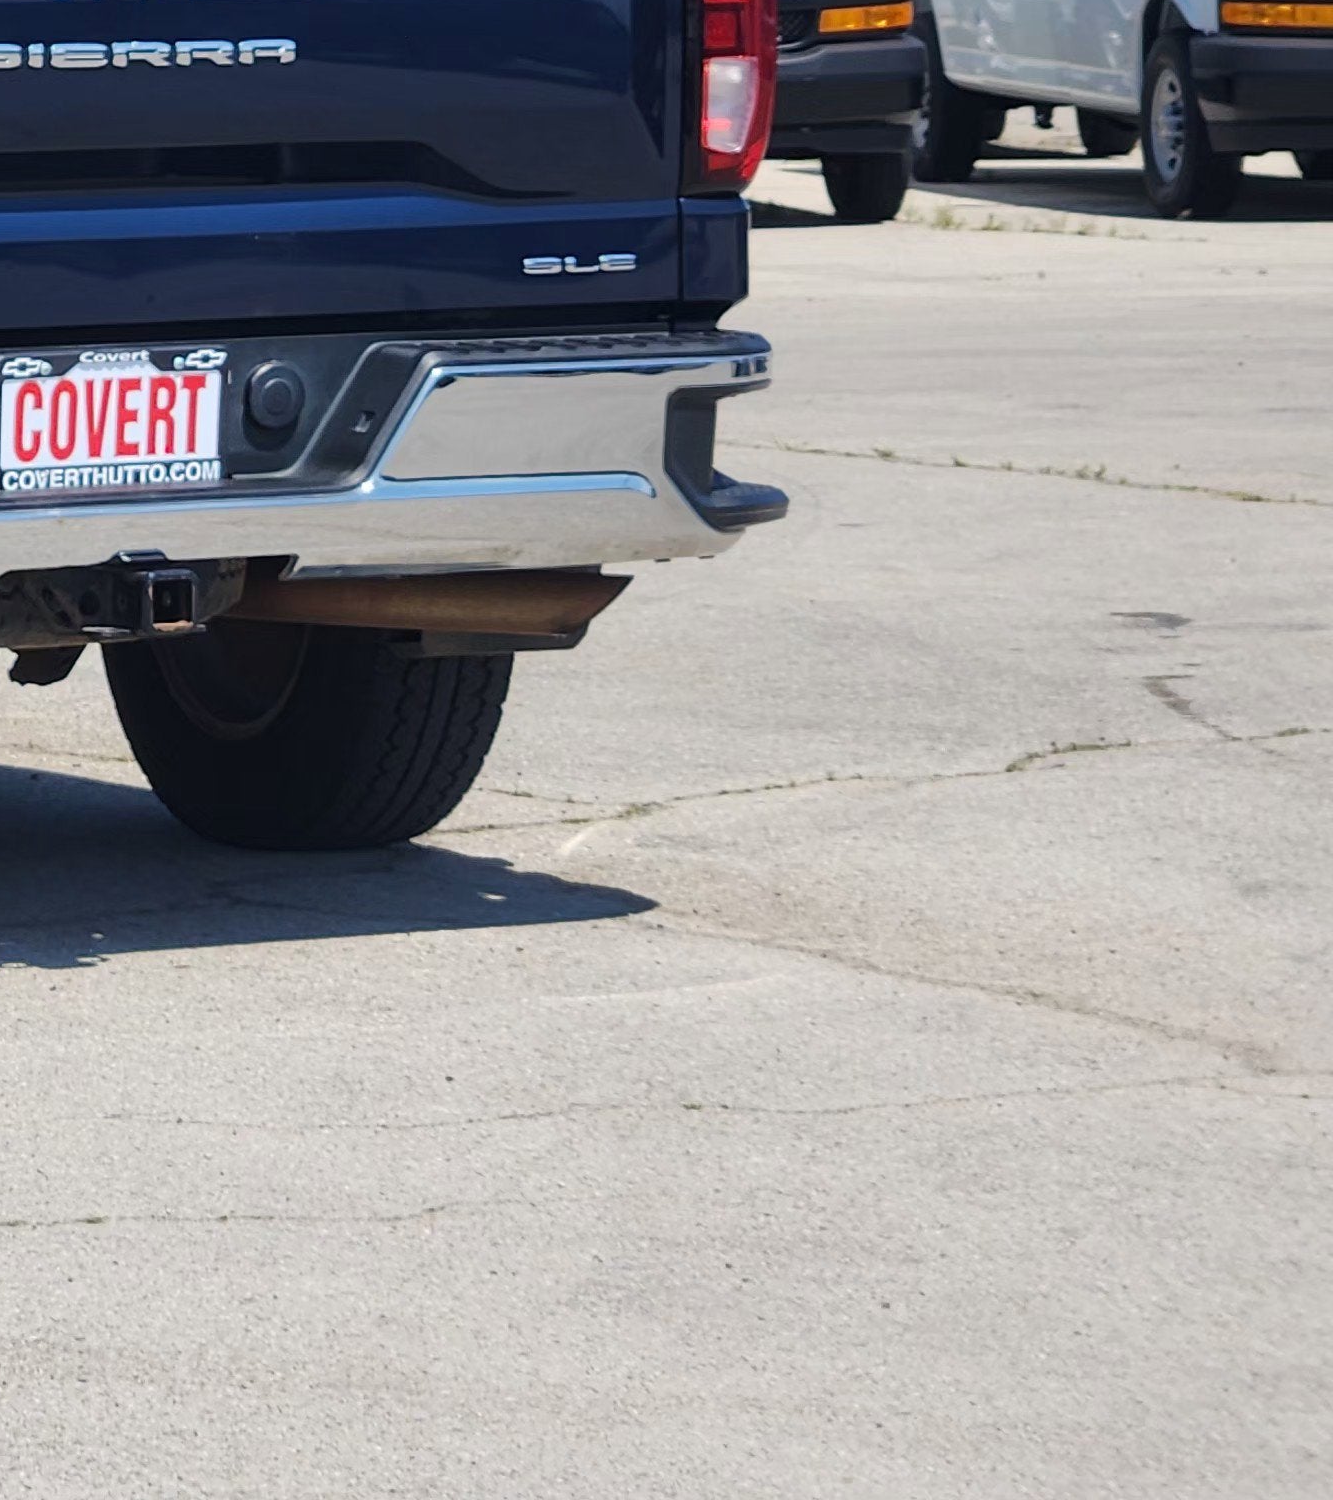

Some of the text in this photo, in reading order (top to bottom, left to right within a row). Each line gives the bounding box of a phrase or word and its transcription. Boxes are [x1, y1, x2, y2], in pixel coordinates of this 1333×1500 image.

[522, 253, 637, 275] SLE
[79, 350, 150, 363] Covert
[13, 374, 207, 463] COVERT
[2, 460, 221, 491] COVERTHUTTO.COM
